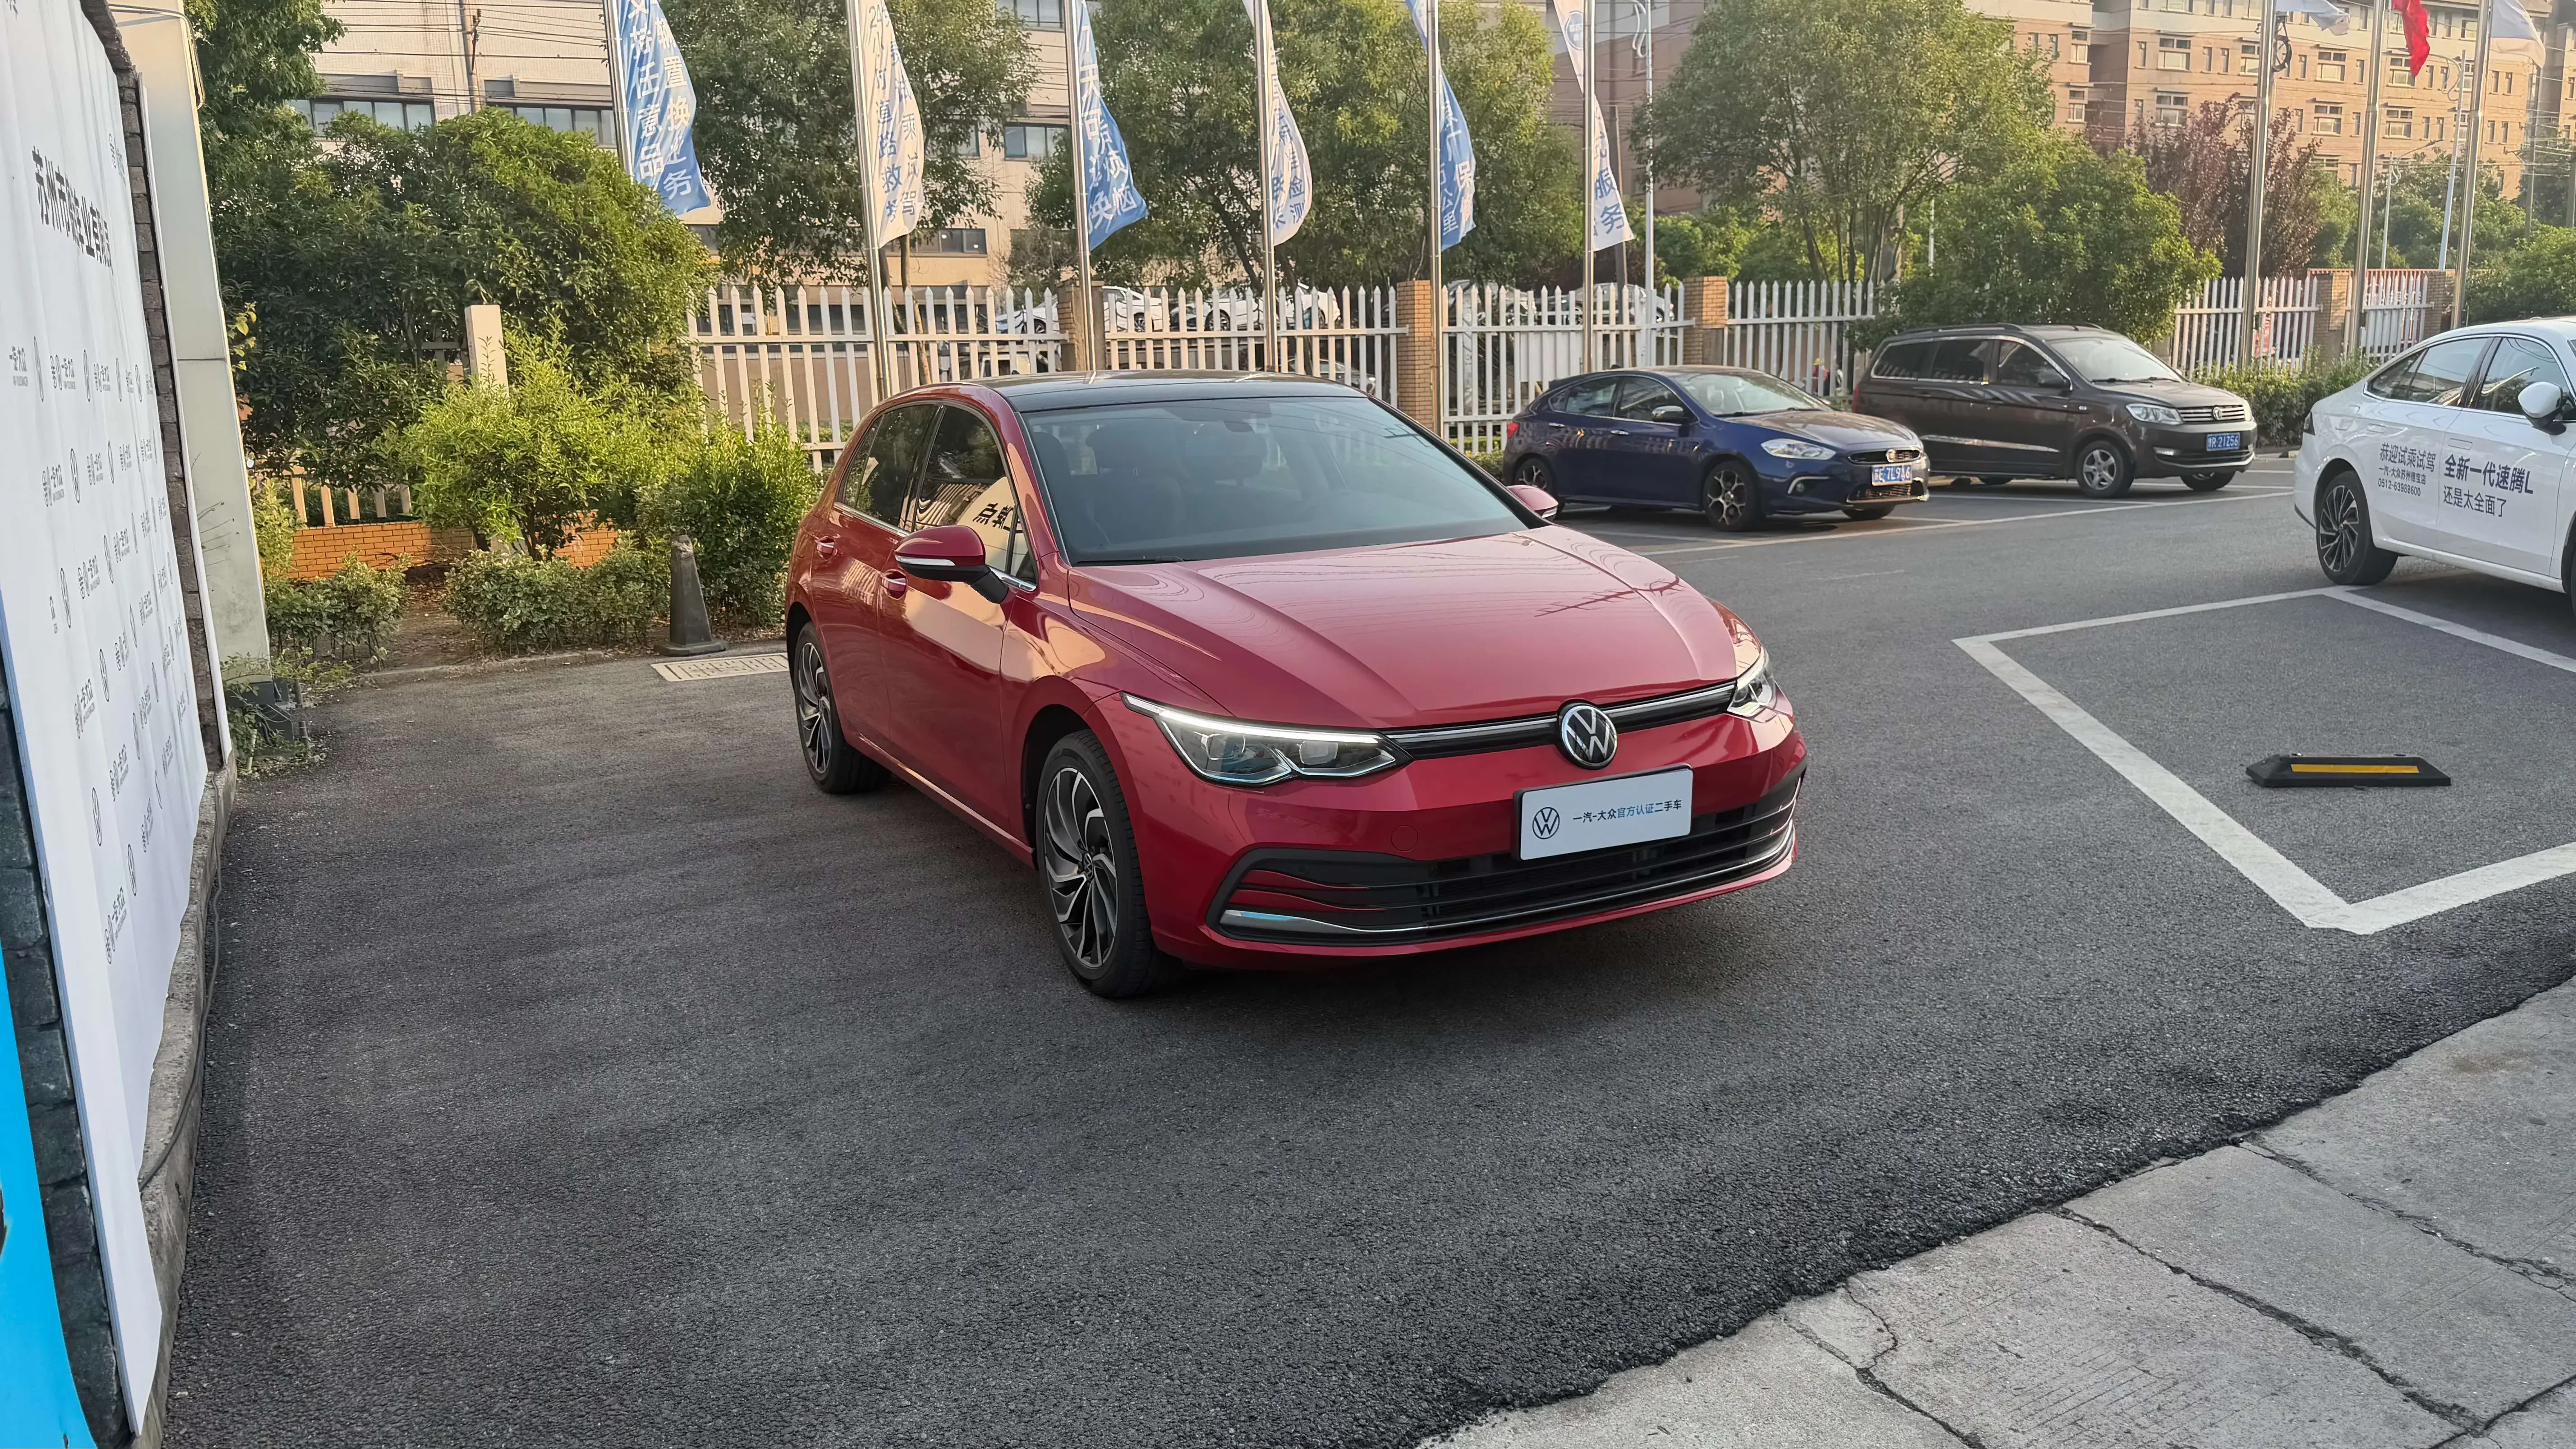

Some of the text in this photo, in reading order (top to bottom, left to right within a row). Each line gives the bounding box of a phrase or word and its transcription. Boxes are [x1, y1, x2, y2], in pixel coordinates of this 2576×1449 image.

[2380, 442, 2436, 472] 恭迎试乘试驾
[2444, 454, 2533, 494] 全新一代速腾L
[2443, 485, 2507, 517] 还是太全面了
[1573, 799, 1682, 823] 一汽-大众官方认证二手车
